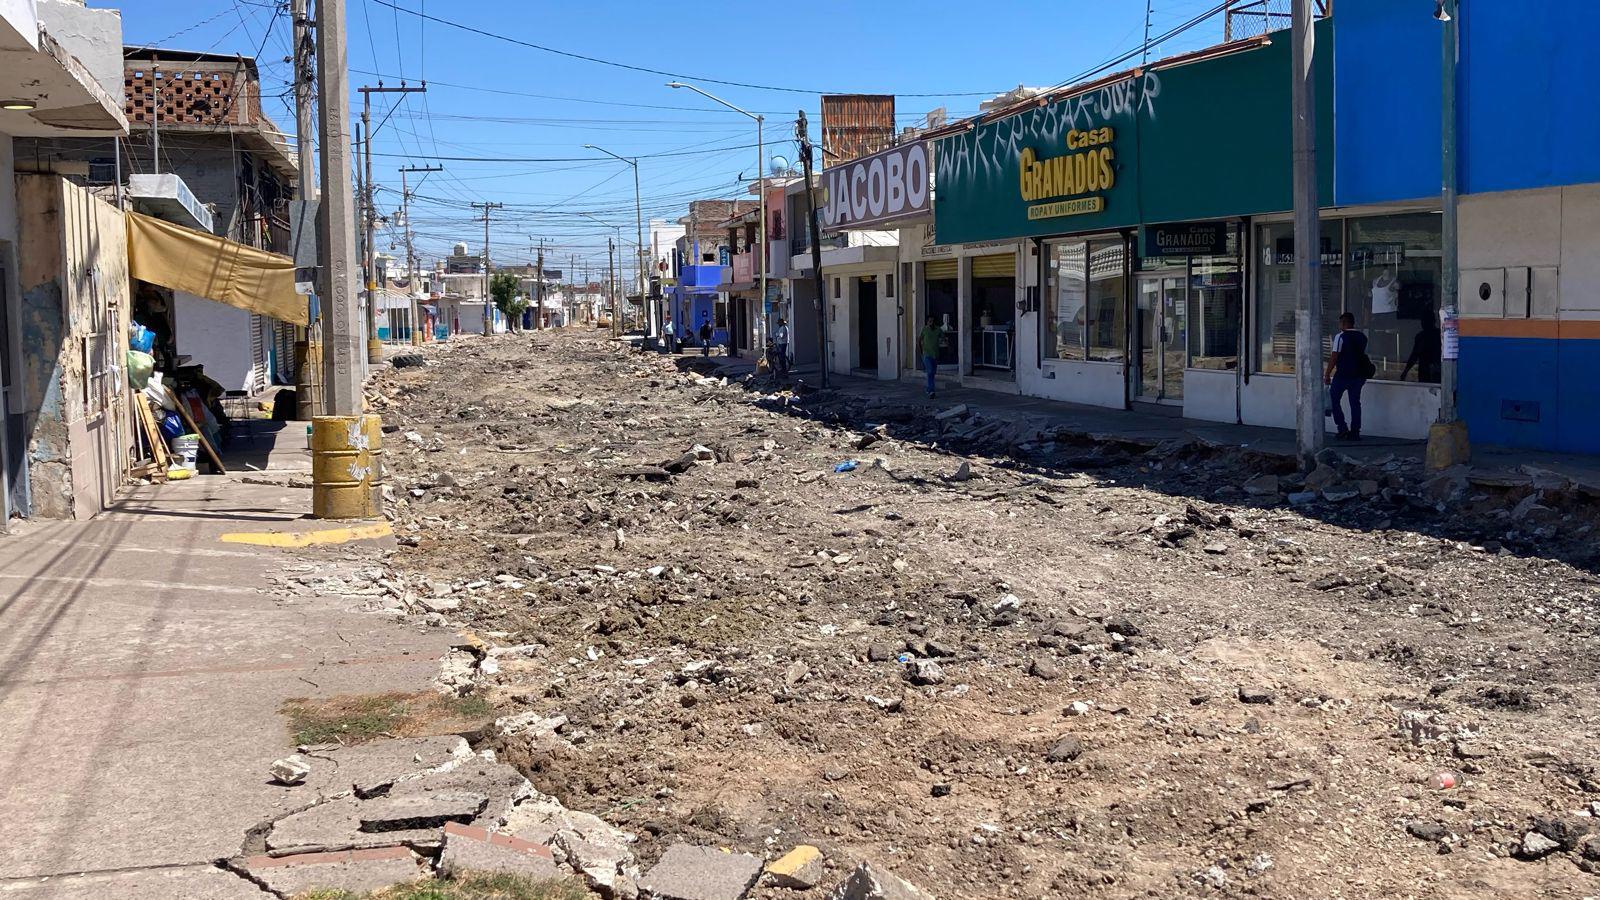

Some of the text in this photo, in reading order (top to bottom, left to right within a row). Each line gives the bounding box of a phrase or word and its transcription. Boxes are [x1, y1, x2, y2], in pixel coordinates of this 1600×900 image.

[1066, 127, 1113, 150] Casa
[824, 145, 927, 225] JACOBO
[1020, 147, 1114, 201] GRANADOS
[1030, 206, 1048, 218] ROPA
[1055, 200, 1096, 215] UNIFORMES
[1156, 230, 1216, 246] GRANADOS
